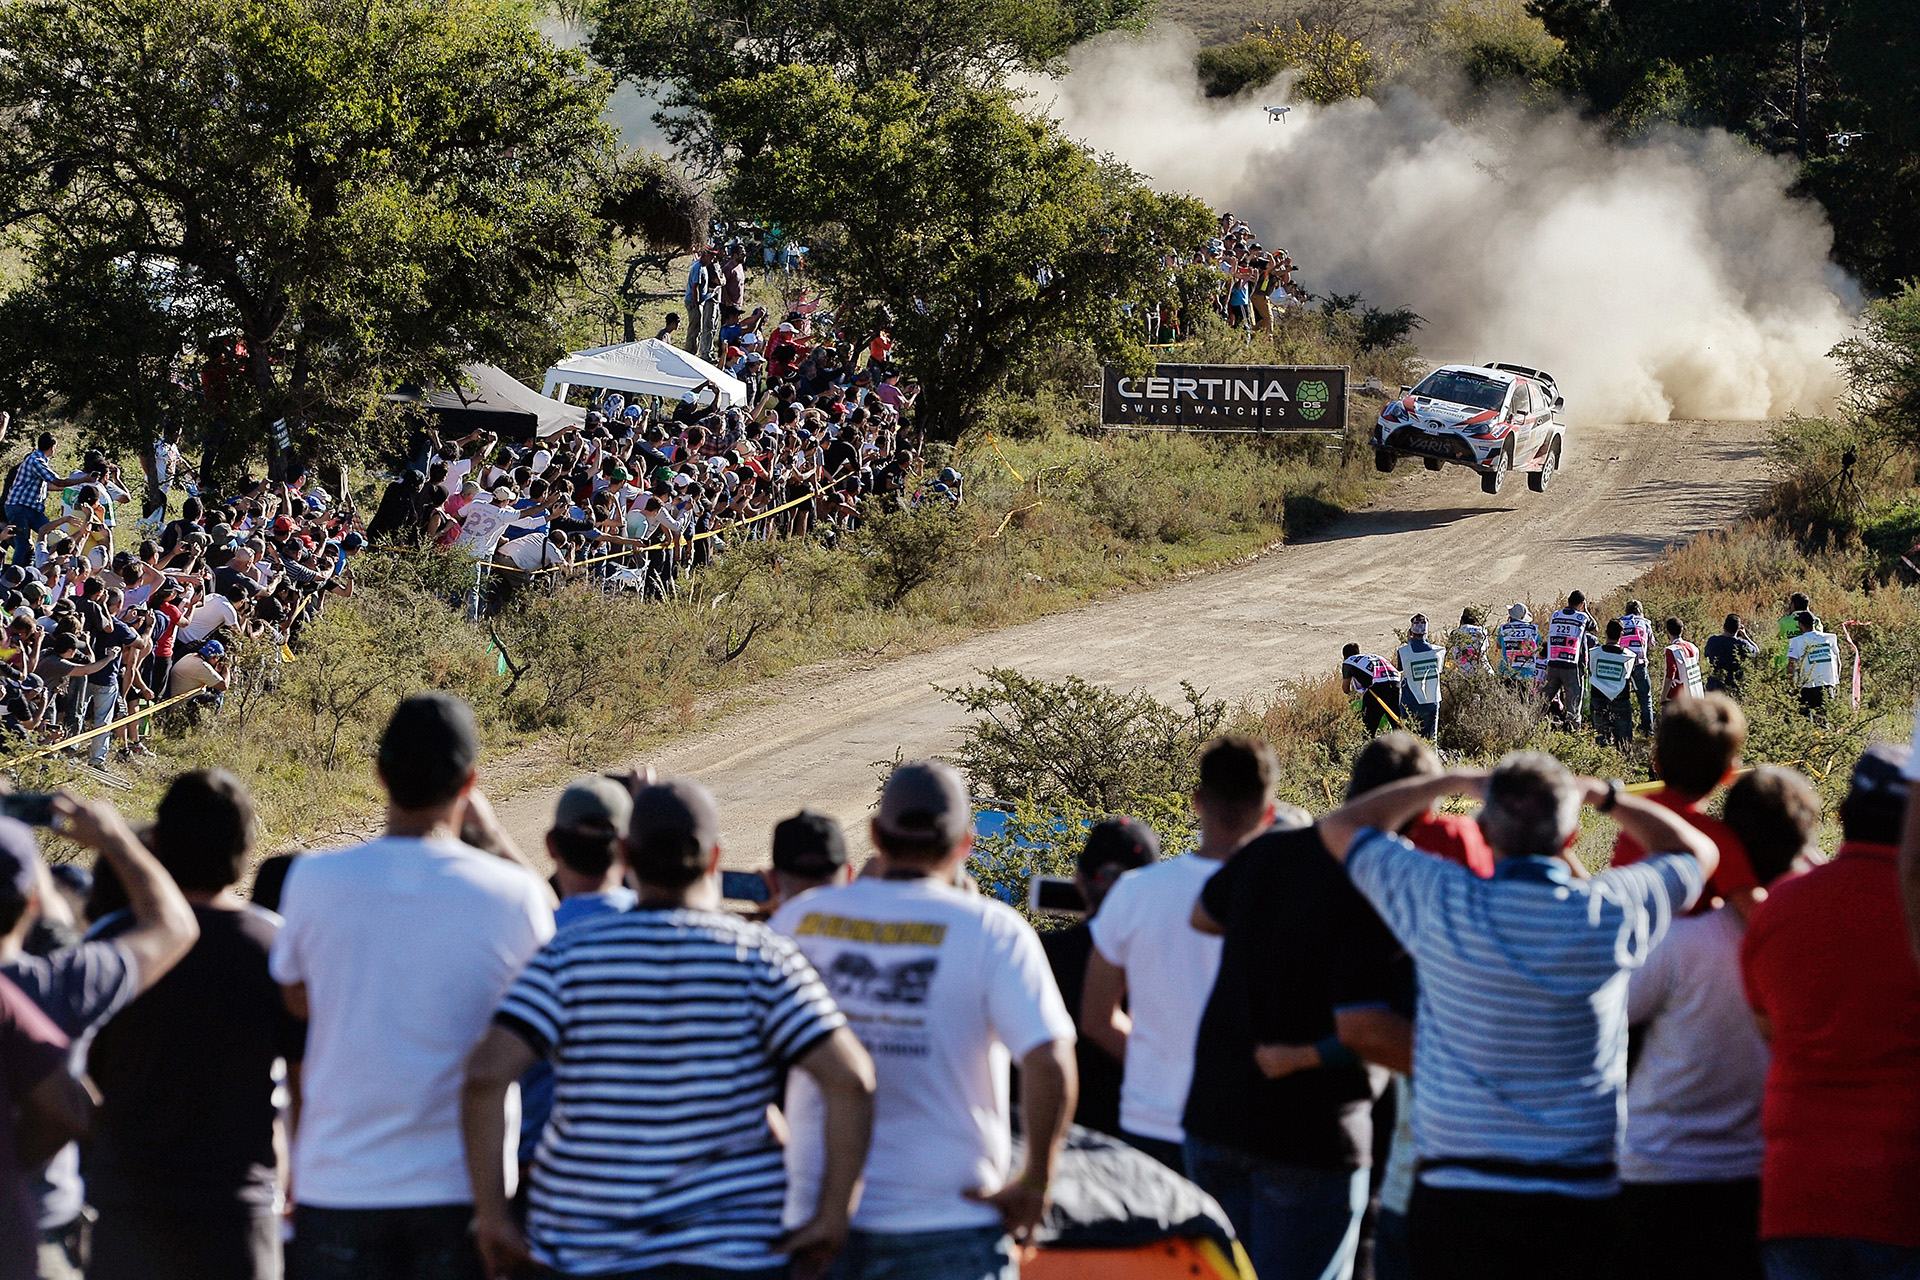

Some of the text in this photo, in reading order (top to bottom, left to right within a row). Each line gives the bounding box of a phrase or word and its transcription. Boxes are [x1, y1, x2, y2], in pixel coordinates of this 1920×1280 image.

[1455, 375, 1484, 386] Lexar
[1117, 377, 1290, 402] CERTINA
[1120, 404, 1286, 416] SWISS WATCHES
[1302, 401, 1322, 409] DS
[1430, 408, 1465, 420] Microsoft
[1408, 436, 1452, 453] YARIS
[463, 512, 496, 536] 23
[1510, 630, 1526, 638] 223
[1556, 625, 1571, 634] 229
